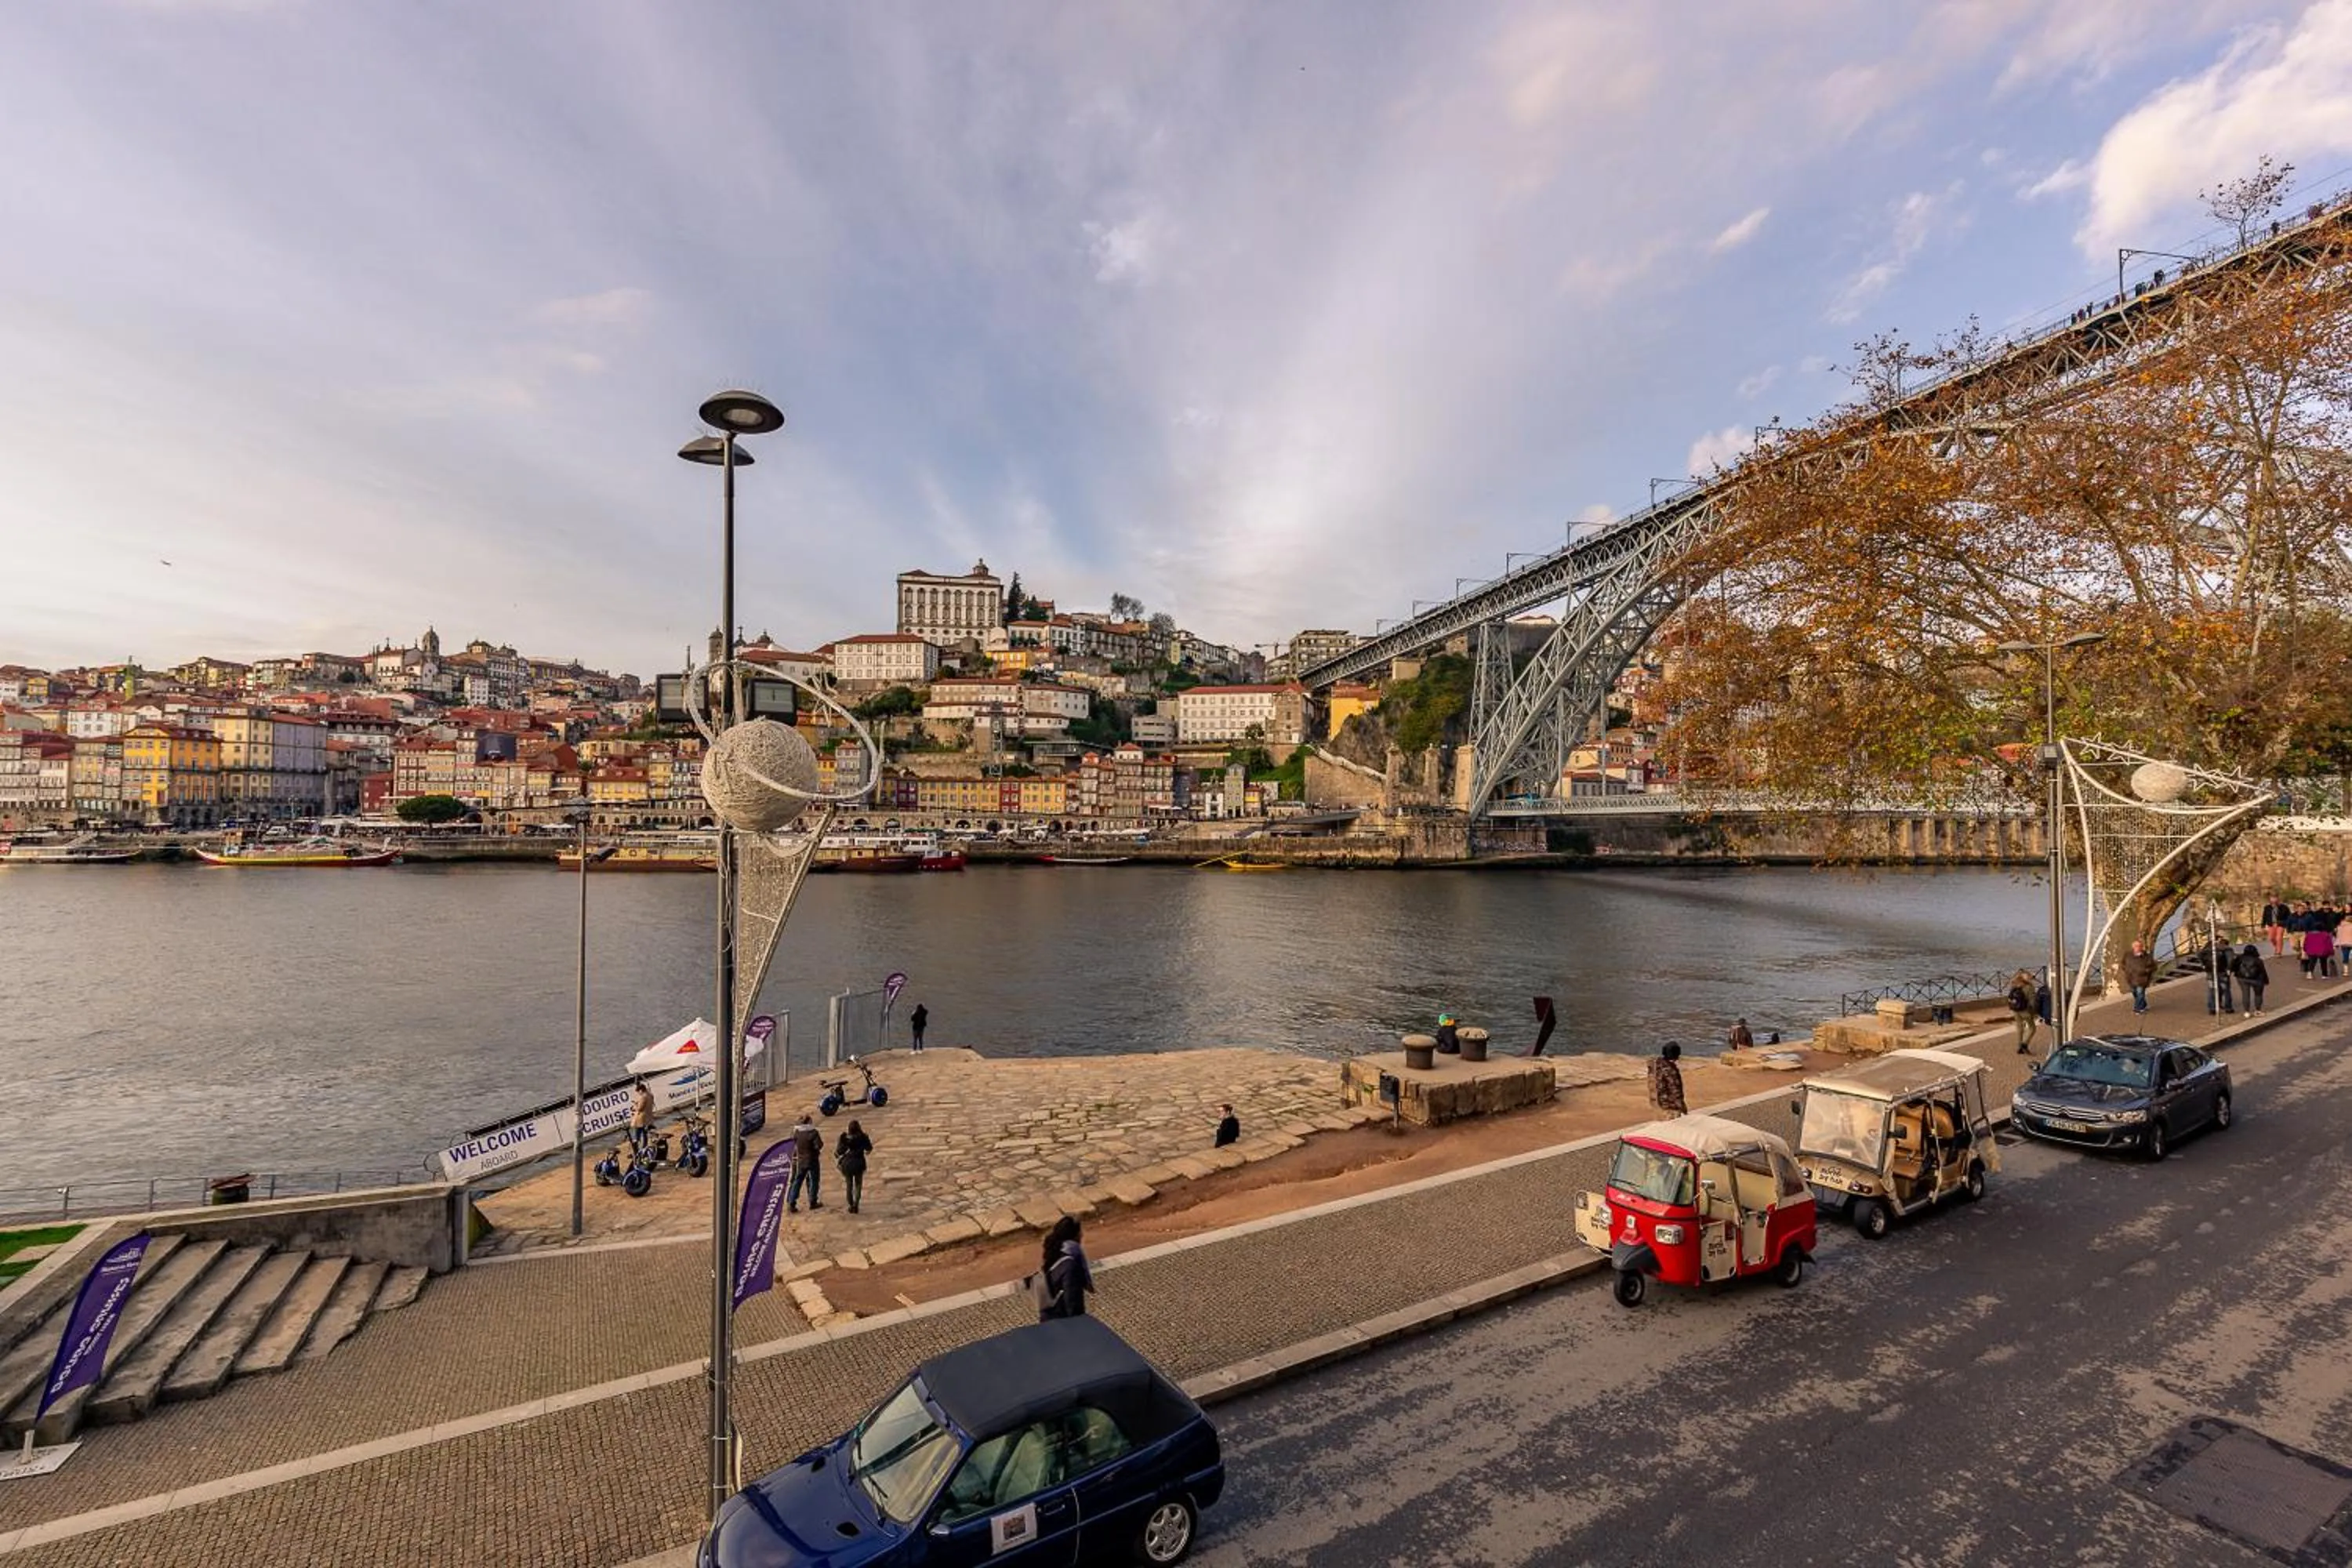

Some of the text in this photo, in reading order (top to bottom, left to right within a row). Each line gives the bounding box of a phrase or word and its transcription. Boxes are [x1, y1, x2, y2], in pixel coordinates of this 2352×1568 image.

[583, 1091, 630, 1116] DOURO
[448, 1122, 537, 1163] WELCOME
[480, 1149, 518, 1171] ABOARD
[735, 1240, 760, 1298] DOURO
[757, 1183, 783, 1238] CRUISES
